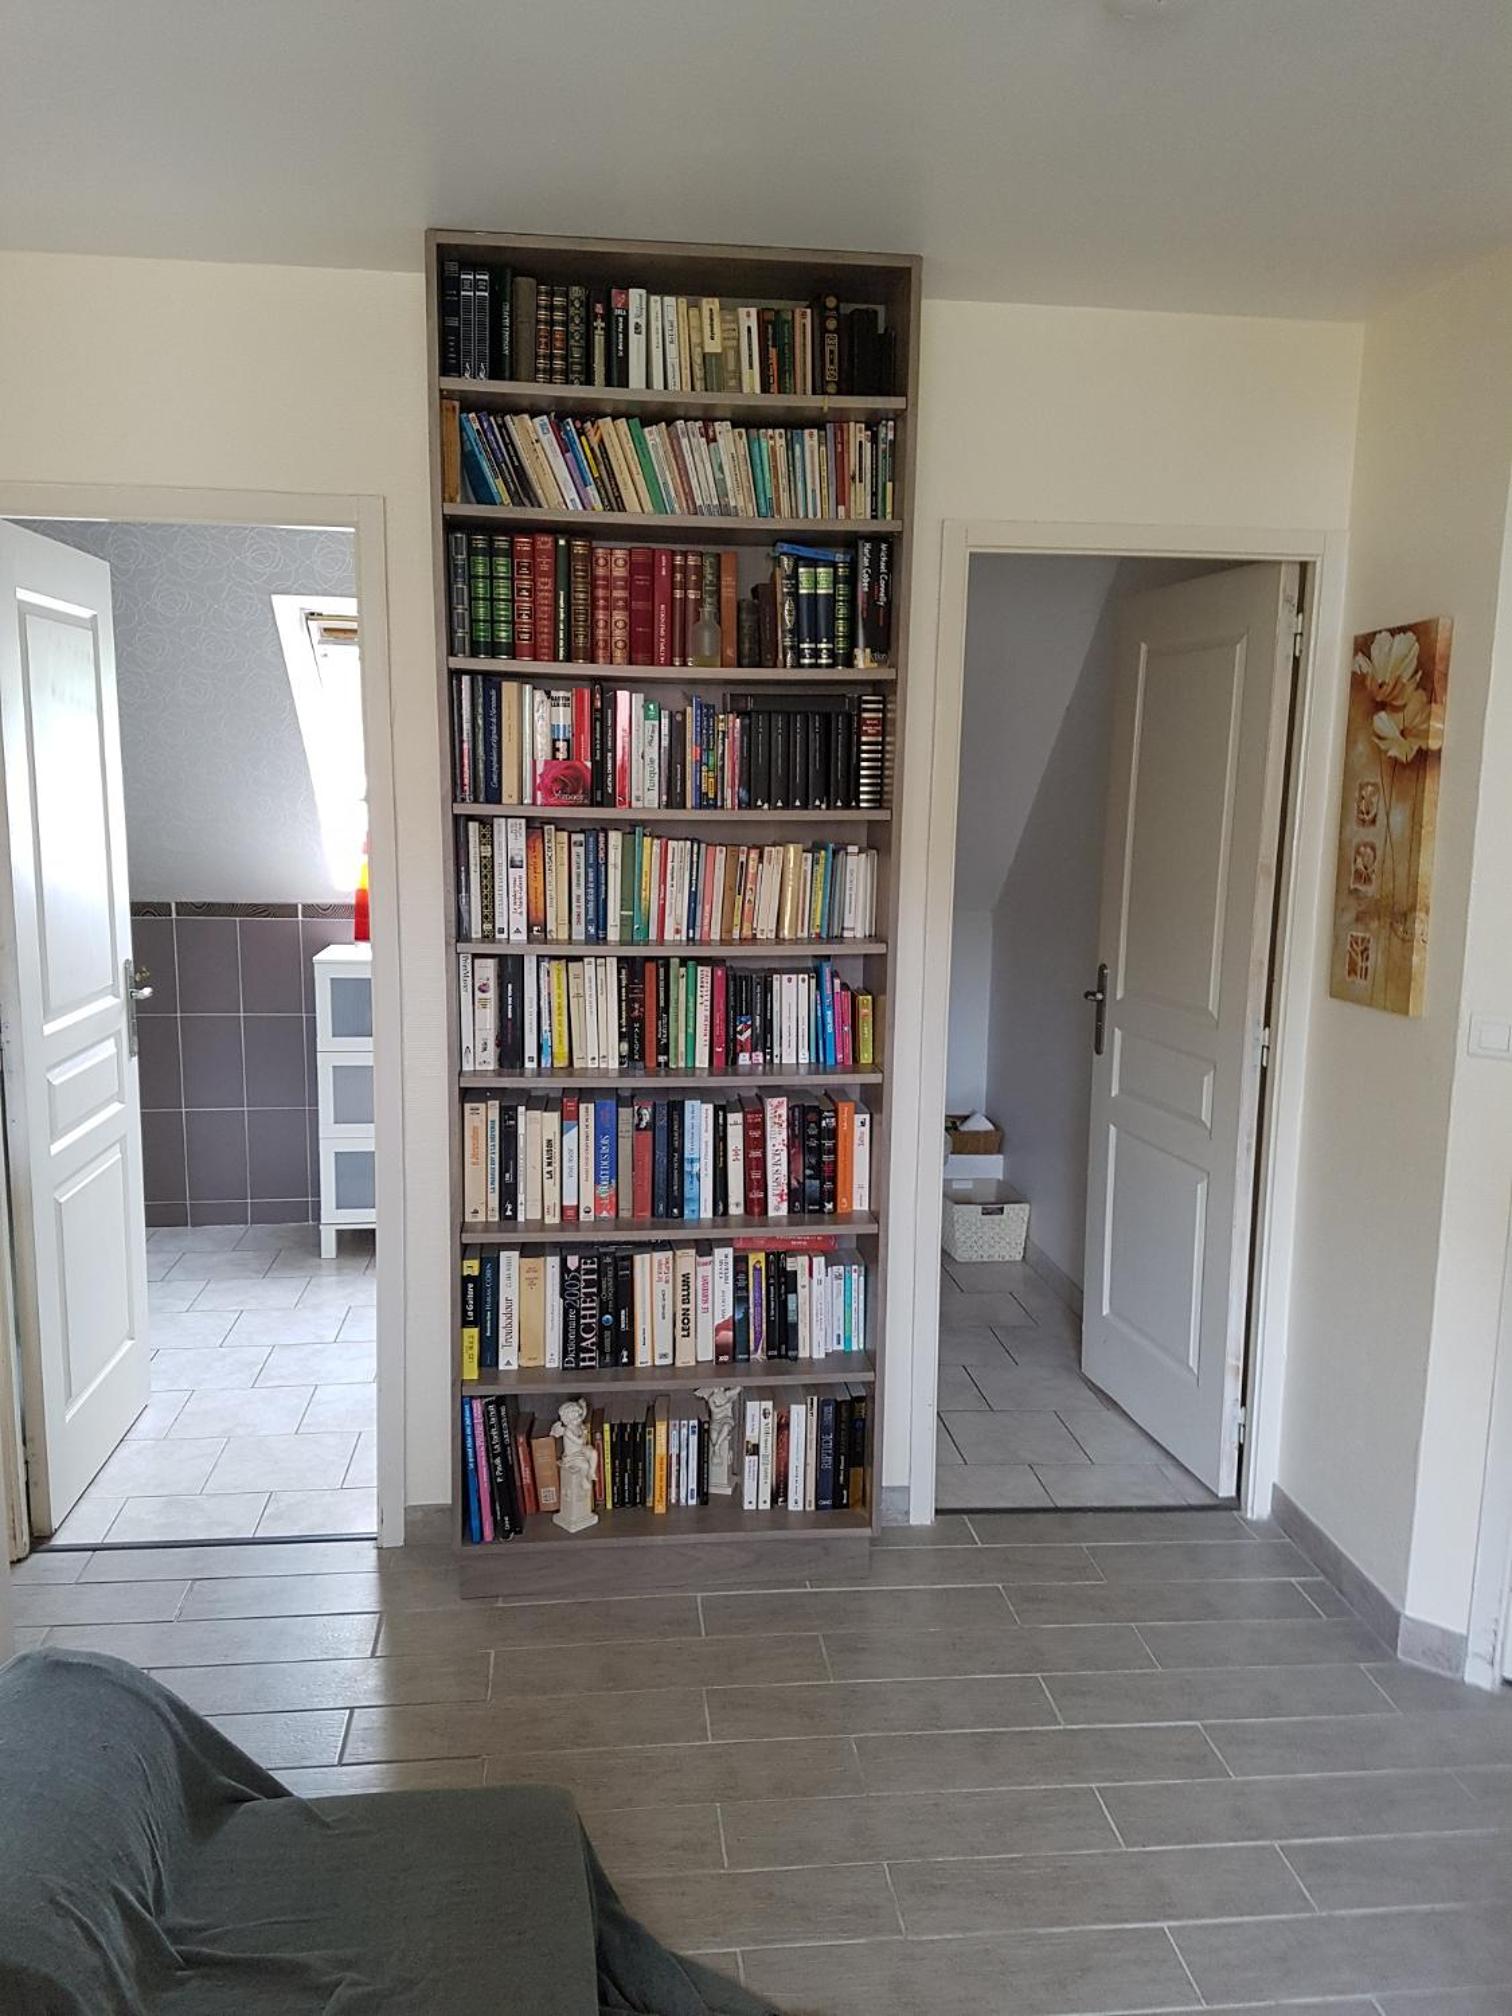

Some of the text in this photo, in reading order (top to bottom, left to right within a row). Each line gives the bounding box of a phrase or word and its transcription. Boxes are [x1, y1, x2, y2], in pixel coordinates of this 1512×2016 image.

[863, 543, 872, 567] Harlan
[863, 569, 871, 592] Coben
[877, 543, 889, 606] Michael Connelly
[647, 756, 656, 792] Turquie
[546, 1170, 552, 1180] LA
[466, 1311, 474, 1321] La
[501, 1297, 513, 1349] Troubadour
[564, 1272, 580, 1368] Dictionnaire 2005
[580, 1258, 598, 1367] HACHETTE
[681, 1272, 690, 1338] LEON BLUM
[820, 1432, 832, 1469] RIPTIDE
